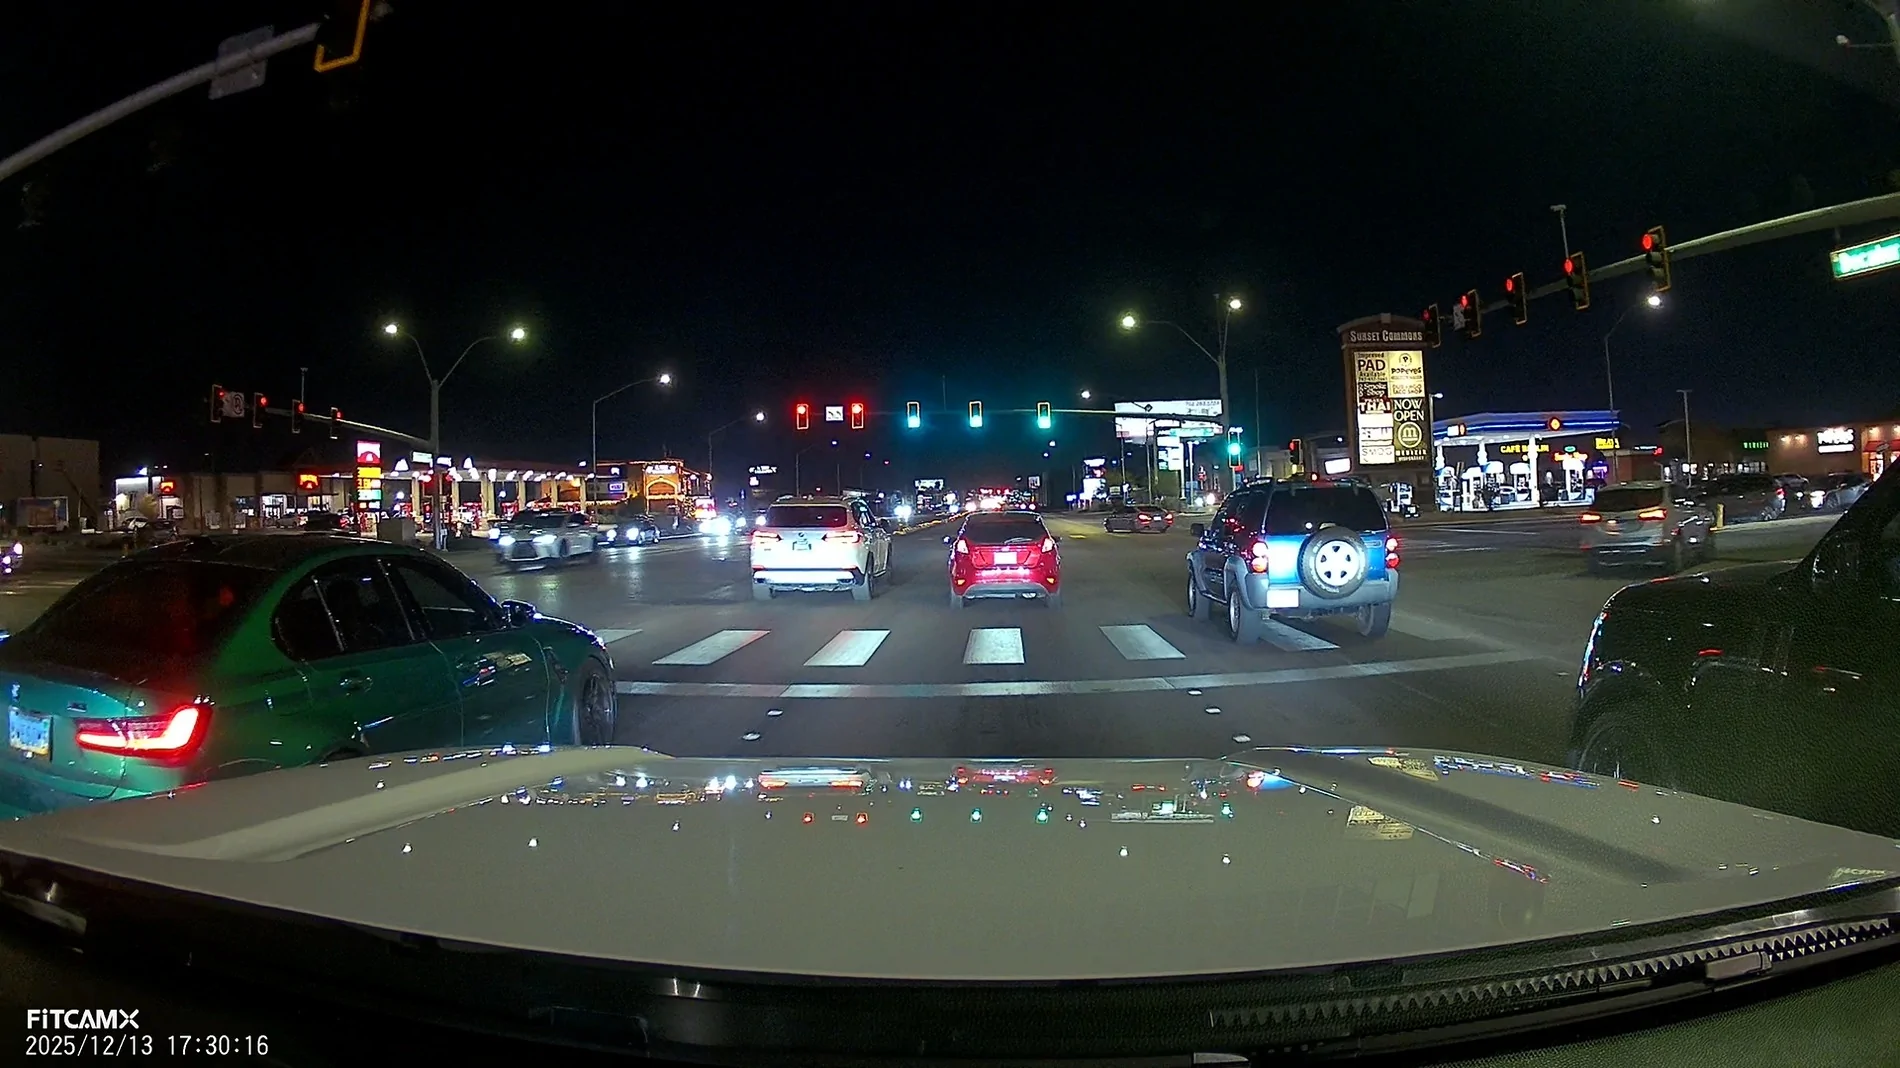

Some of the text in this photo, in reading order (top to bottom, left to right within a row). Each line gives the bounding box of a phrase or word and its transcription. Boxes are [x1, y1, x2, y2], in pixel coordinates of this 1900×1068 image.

[1358, 359, 1386, 371] PAD
[1359, 401, 1391, 412] THAI
[1393, 399, 1423, 410] NOW
[1394, 410, 1425, 422] OPEN
